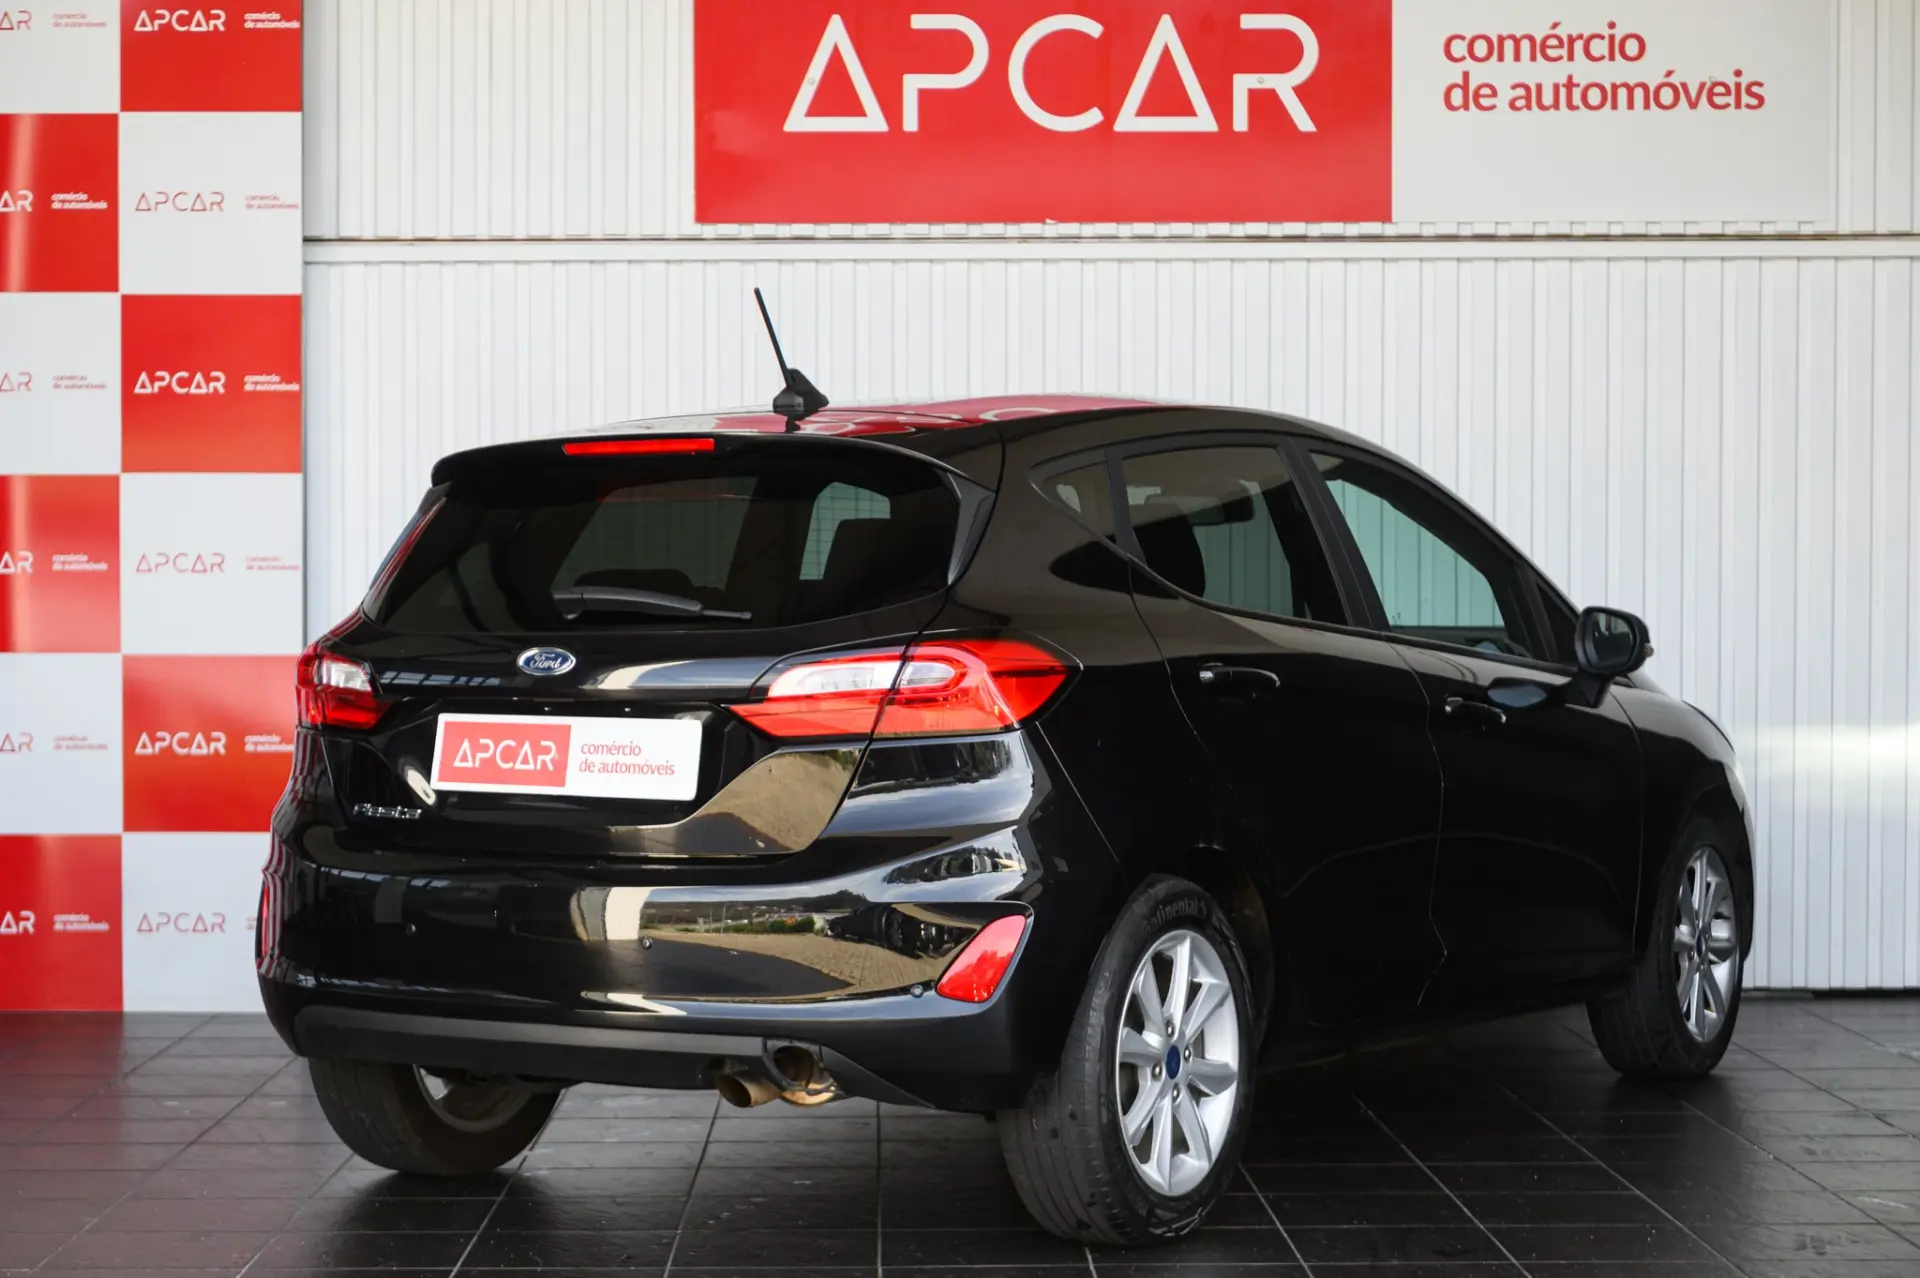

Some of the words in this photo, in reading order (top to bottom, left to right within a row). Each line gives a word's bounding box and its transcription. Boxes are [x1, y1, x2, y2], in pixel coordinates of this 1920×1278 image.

[134, 9, 226, 31] APCAR
[1443, 21, 1646, 63] comércio
[783, 13, 1319, 134] APCAR
[1443, 71, 1498, 111] de
[1508, 69, 1766, 111] automóveis
[135, 191, 225, 212] APCAR
[133, 371, 226, 394] APCAR
[136, 552, 225, 573] APCAR
[530, 652, 562, 669] Ford
[135, 731, 227, 756] APCAR
[453, 738, 557, 771] APCAR
[581, 740, 642, 756] comércio
[579, 757, 596, 773] de
[598, 760, 675, 775] automóveis
[137, 912, 226, 933] APCAR
